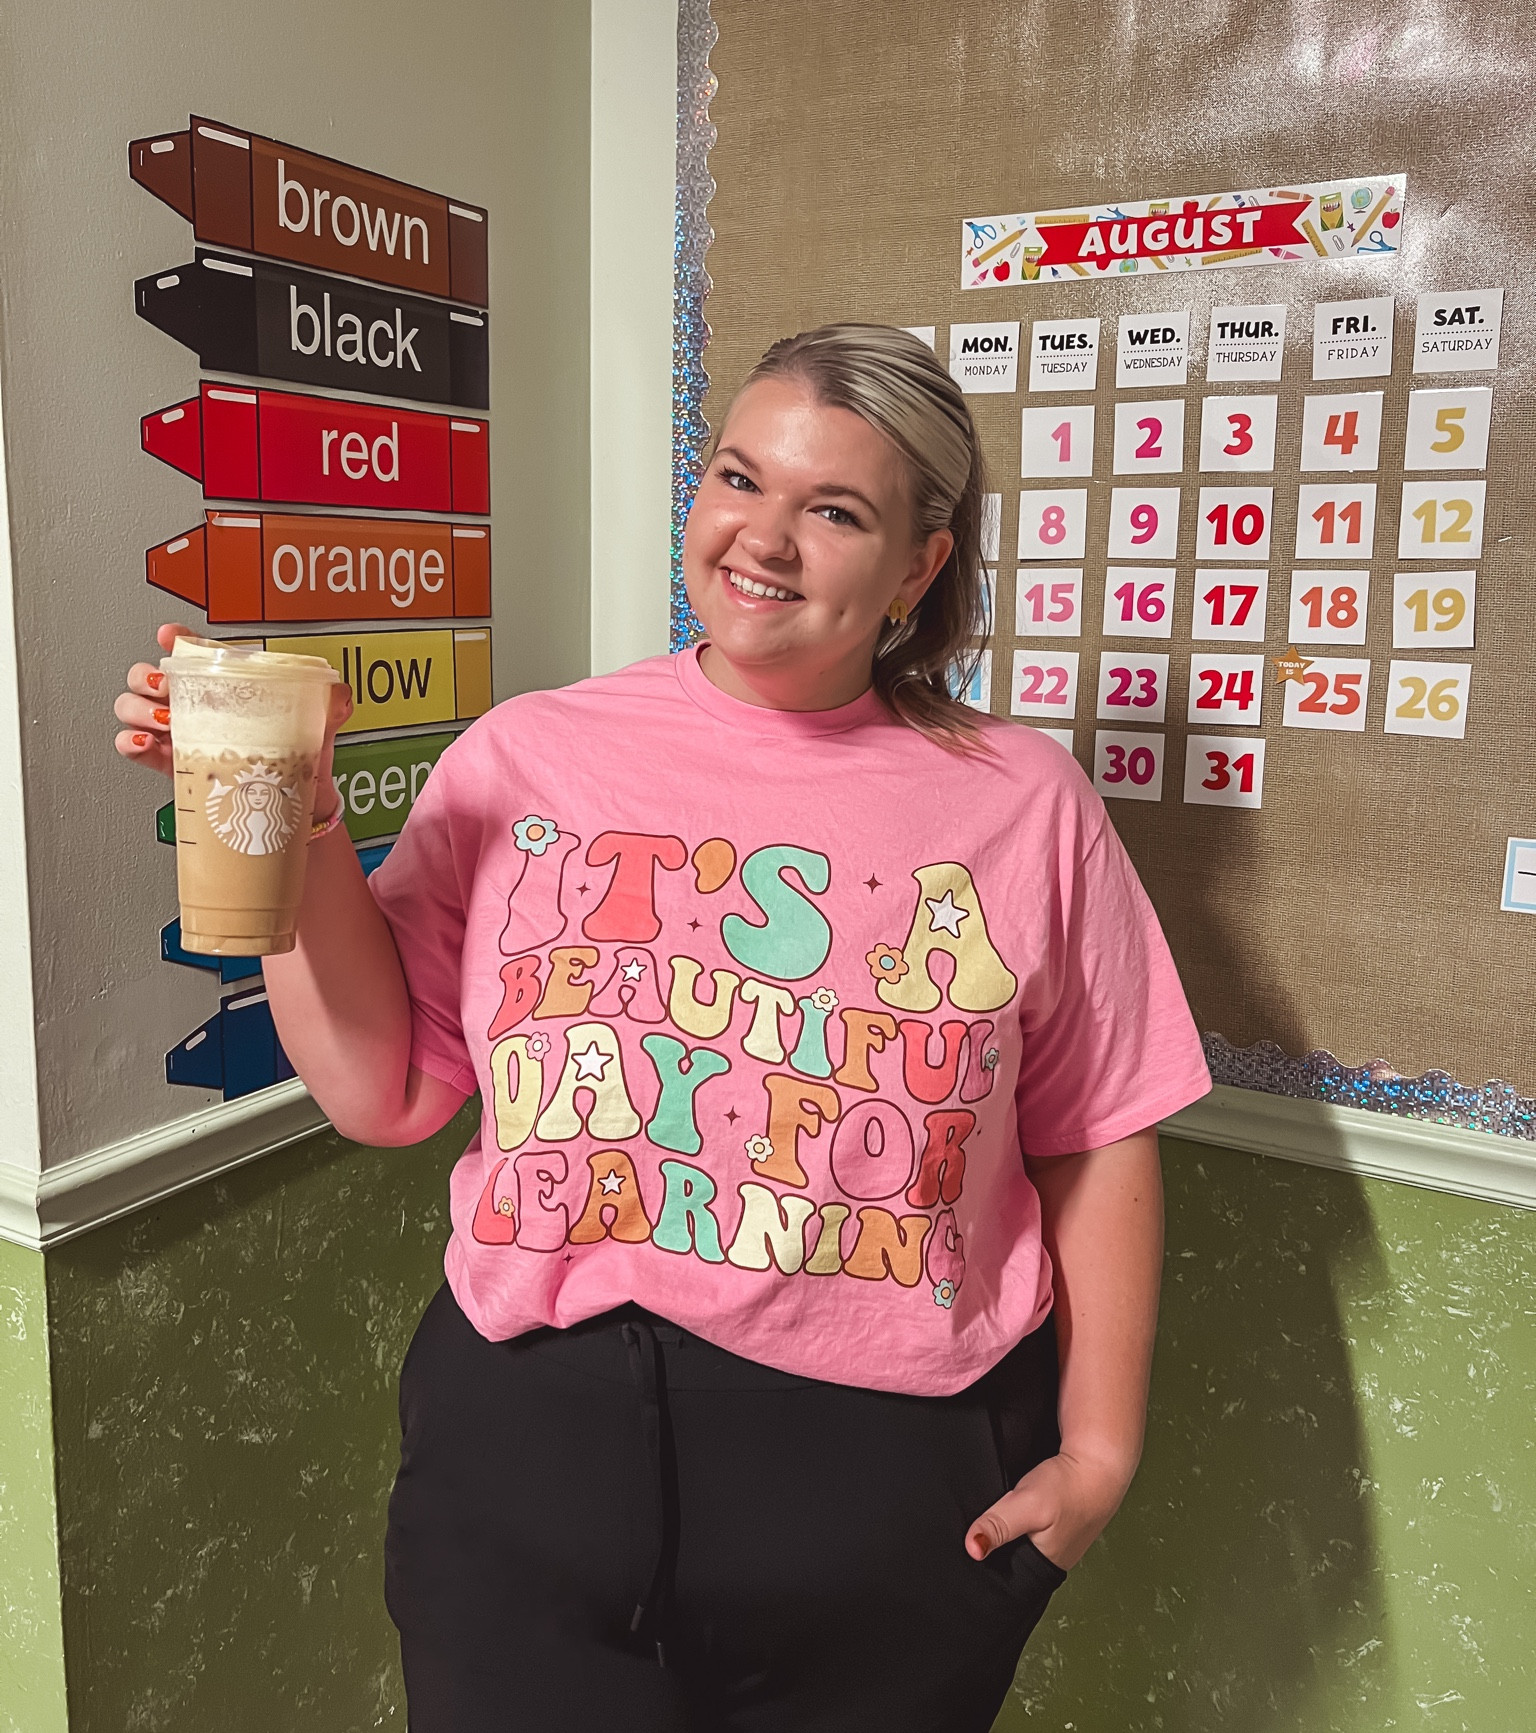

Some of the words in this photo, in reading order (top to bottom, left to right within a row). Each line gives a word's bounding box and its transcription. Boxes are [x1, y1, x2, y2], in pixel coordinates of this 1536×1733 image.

[278, 159, 428, 264] brown
[1078, 210, 1262, 258] AUGUST
[290, 285, 422, 372] black
[1218, 321, 1278, 338] THUR.
[1332, 316, 1377, 336] FRI.
[1434, 306, 1484, 326] SAT.
[962, 336, 1012, 353] MON.
[1039, 334, 1093, 351] TUES.
[1128, 328, 1180, 345] WED.
[1216, 351, 1276, 362] THURSDAY
[1328, 346, 1378, 360] FRIDAY
[1422, 338, 1492, 352] SATURDAY
[965, 365, 1007, 375] MONDAY
[1041, 362, 1087, 373] TUESDAY
[1124, 357, 1182, 369] WEDNESDAY
[1052, 423, 1070, 461] 1
[1136, 418, 1162, 458] 2
[1224, 414, 1253, 455] 3
[1324, 412, 1359, 454] 4
[1431, 408, 1465, 452] 5
[322, 422, 399, 481] red
[1040, 506, 1065, 544] 8
[1130, 504, 1158, 544] 9
[1206, 504, 1264, 545] 10
[1312, 502, 1361, 543] 11
[1414, 500, 1472, 542] 12
[272, 544, 445, 608] orange
[1025, 584, 1073, 622] 15
[1114, 583, 1165, 622] 16
[1203, 585, 1258, 626] 17
[1301, 587, 1358, 628] 18
[1406, 589, 1465, 631] 19
[343, 646, 432, 704] llow
[1021, 666, 1068, 704] 22
[1278, 661, 1306, 669] TODAY
[1106, 668, 1157, 707] 23
[1196, 670, 1254, 710] 24
[1298, 672, 1362, 715] 25
[1397, 678, 1458, 720] 26
[1102, 745, 1155, 785] 30
[1202, 751, 1254, 792] 31
[333, 761, 433, 815] reen
[499, 829, 833, 981] IT'S
[875, 862, 1018, 1013] A
[488, 946, 996, 1104] BEAUTIFUL
[489, 1022, 732, 1155] DAY
[750, 1074, 977, 1209] FOR
[472, 1150, 966, 1294] LEARNING
